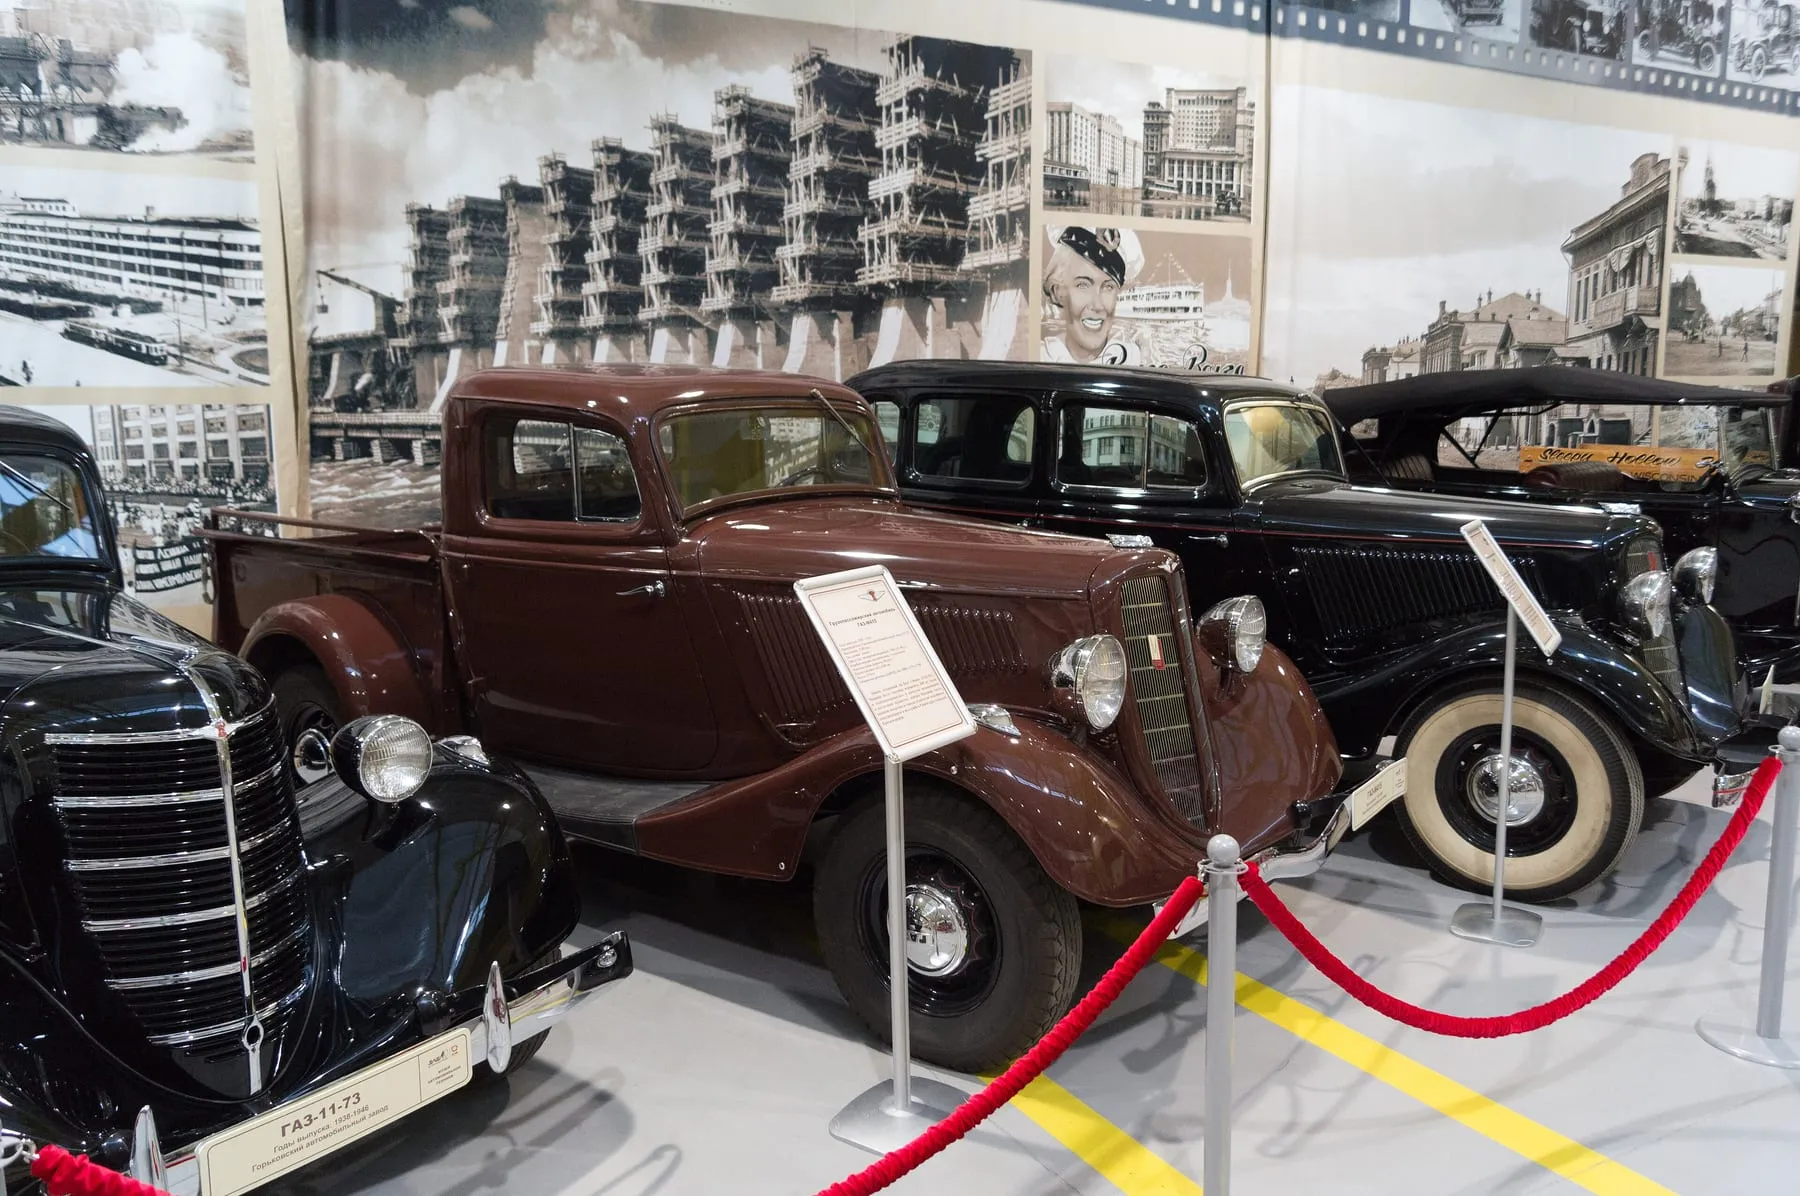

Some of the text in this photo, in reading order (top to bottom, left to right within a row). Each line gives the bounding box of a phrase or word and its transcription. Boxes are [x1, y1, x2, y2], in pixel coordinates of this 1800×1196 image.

[1607, 451, 1682, 466] Hollow
[251, 1105, 389, 1172] Горьковский автомобильный завод
[273, 1105, 369, 1153] Годы выпуска: 1938-1946
[280, 1092, 361, 1138] ГАЗ-11-73
